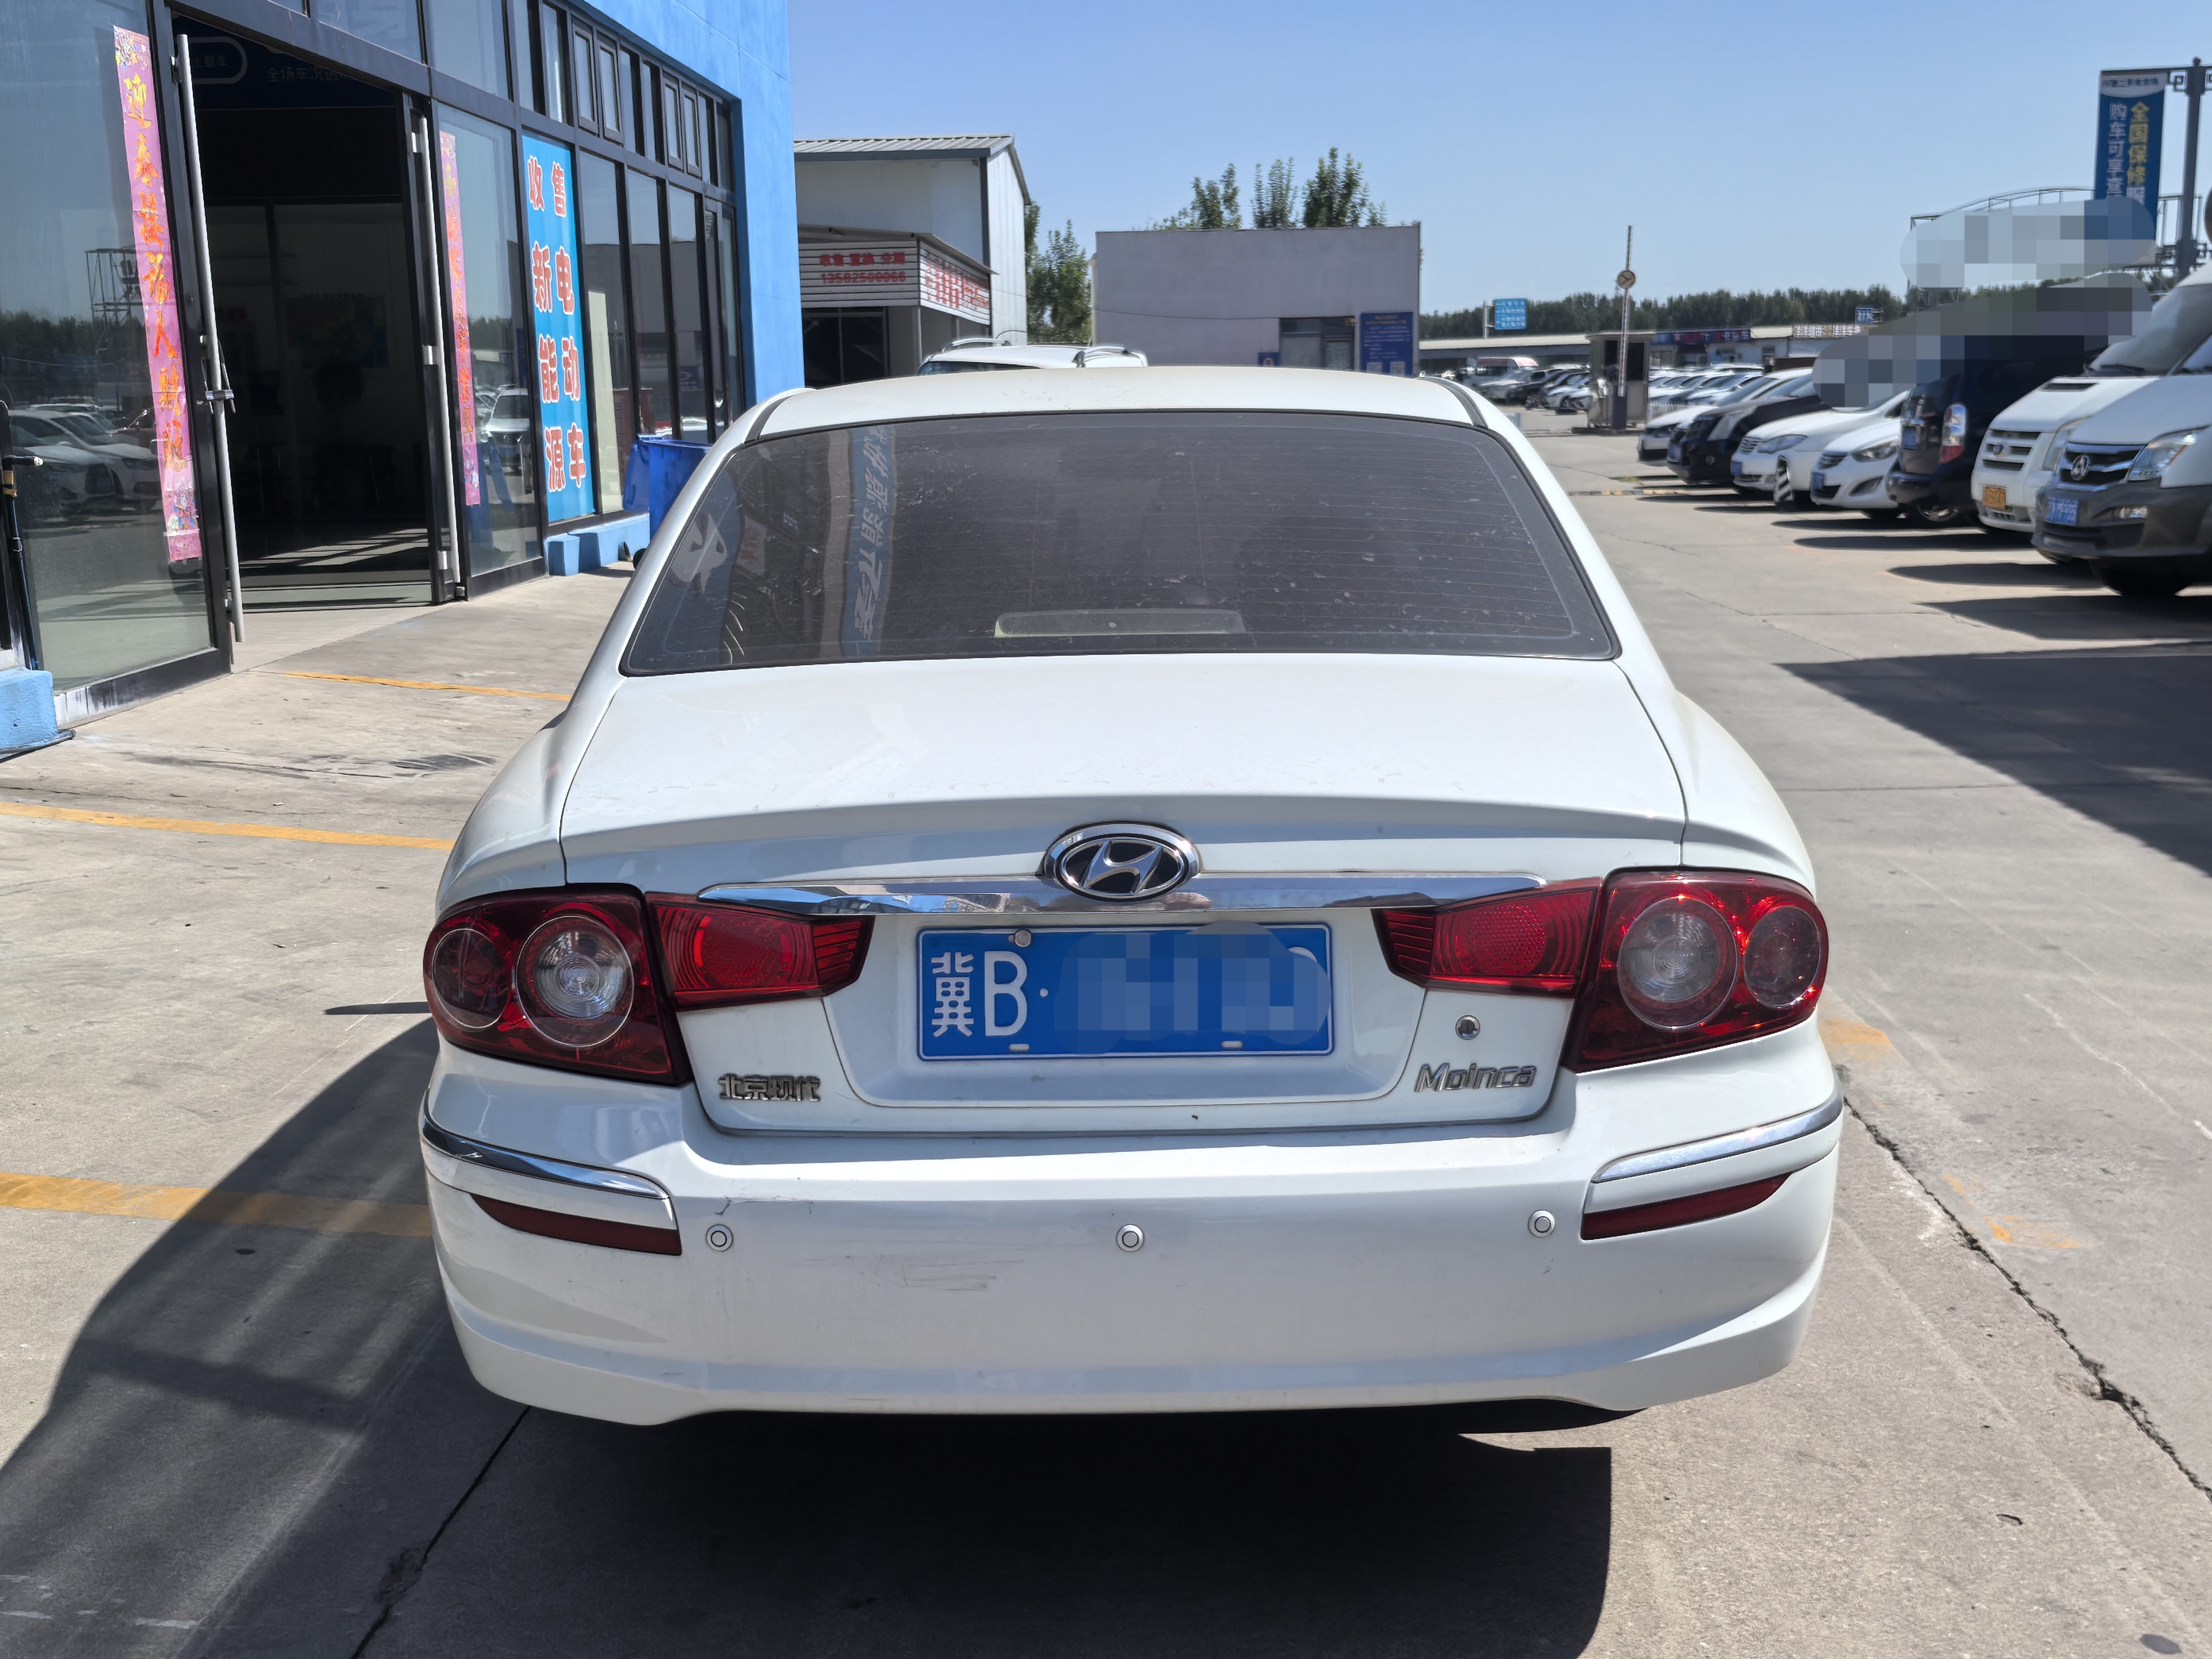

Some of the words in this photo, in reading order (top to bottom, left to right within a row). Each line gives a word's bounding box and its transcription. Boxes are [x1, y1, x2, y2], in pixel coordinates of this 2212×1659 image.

[718, 1073, 821, 1102] 北京现代
[1414, 1062, 1537, 1092] Moinca
